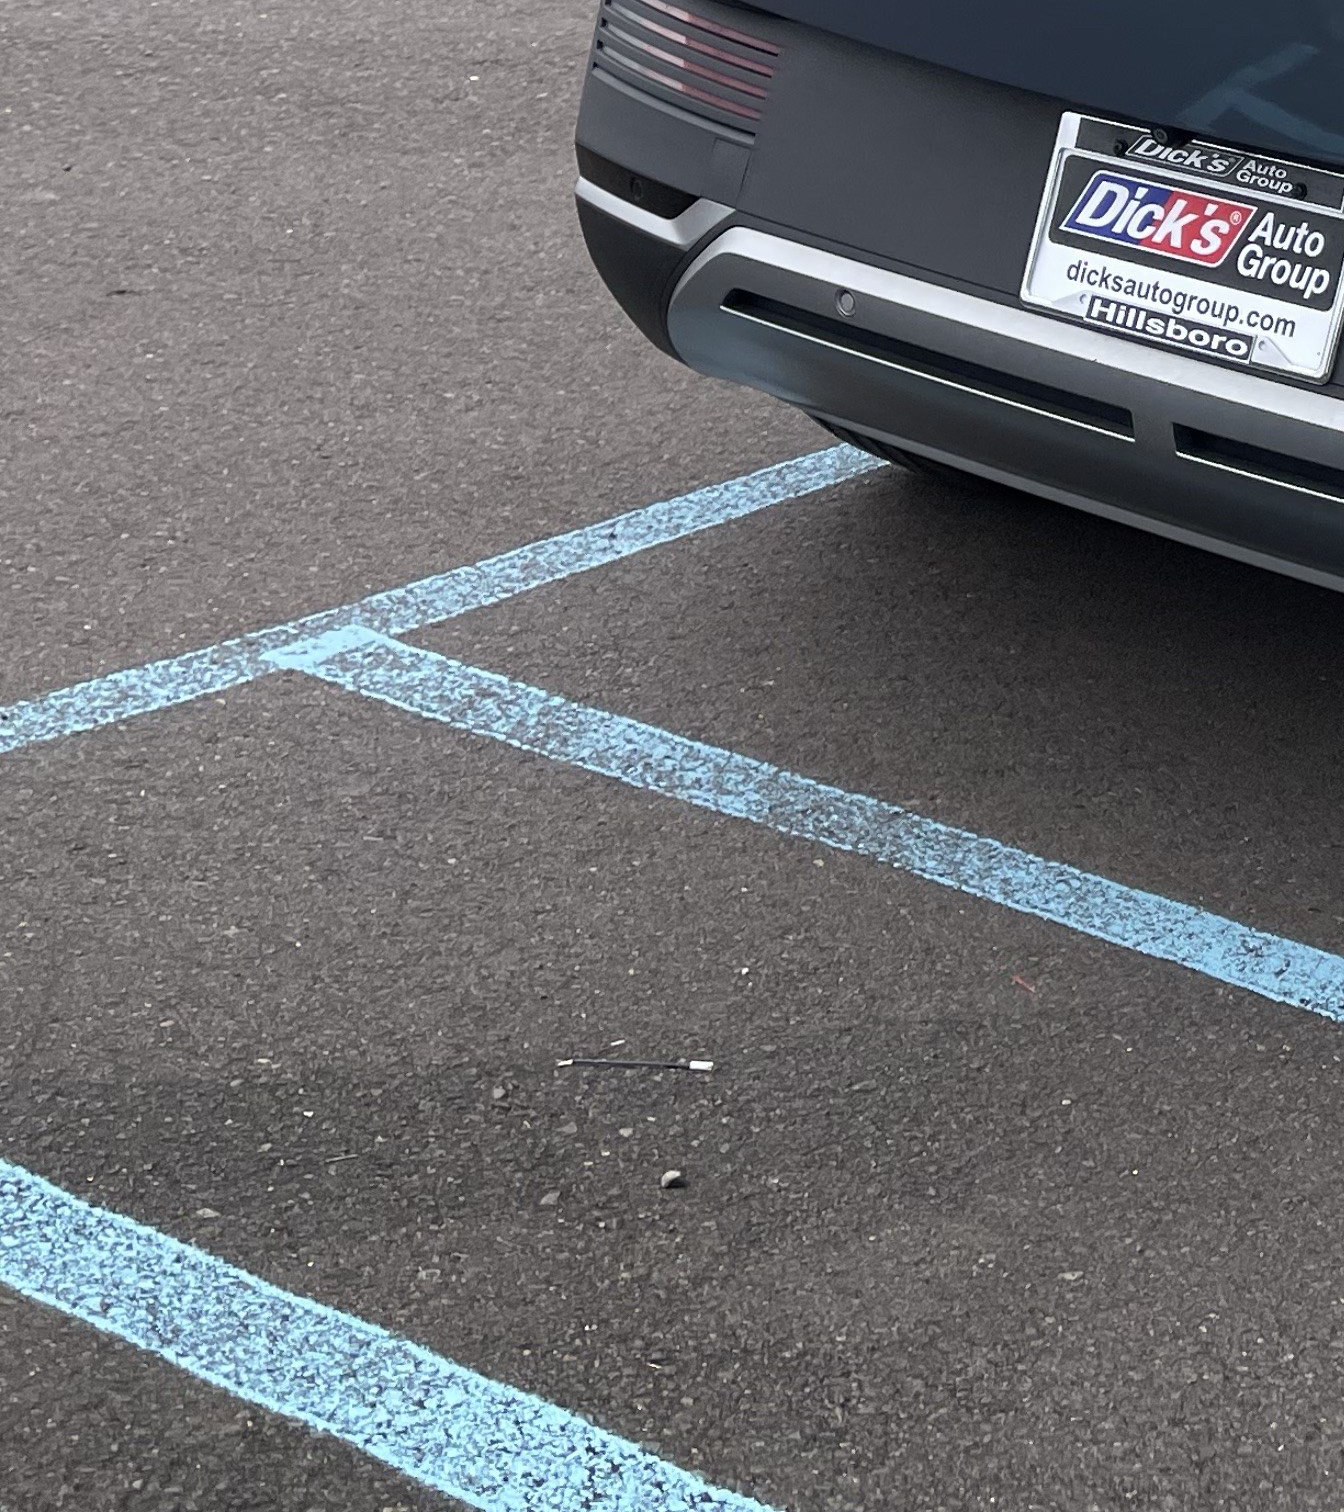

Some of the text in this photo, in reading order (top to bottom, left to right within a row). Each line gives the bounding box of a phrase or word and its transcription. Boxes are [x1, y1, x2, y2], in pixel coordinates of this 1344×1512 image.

[1134, 140, 1230, 173] Dick's
[1243, 159, 1287, 179] Auto
[1236, 170, 1294, 194] Group
[1075, 179, 1230, 257] Dick's
[1247, 212, 1325, 257] Auto
[1236, 244, 1331, 299] Group
[1066, 260, 1296, 338] dicksautogroup.com
[1088, 297, 1249, 358] Hillsboro
